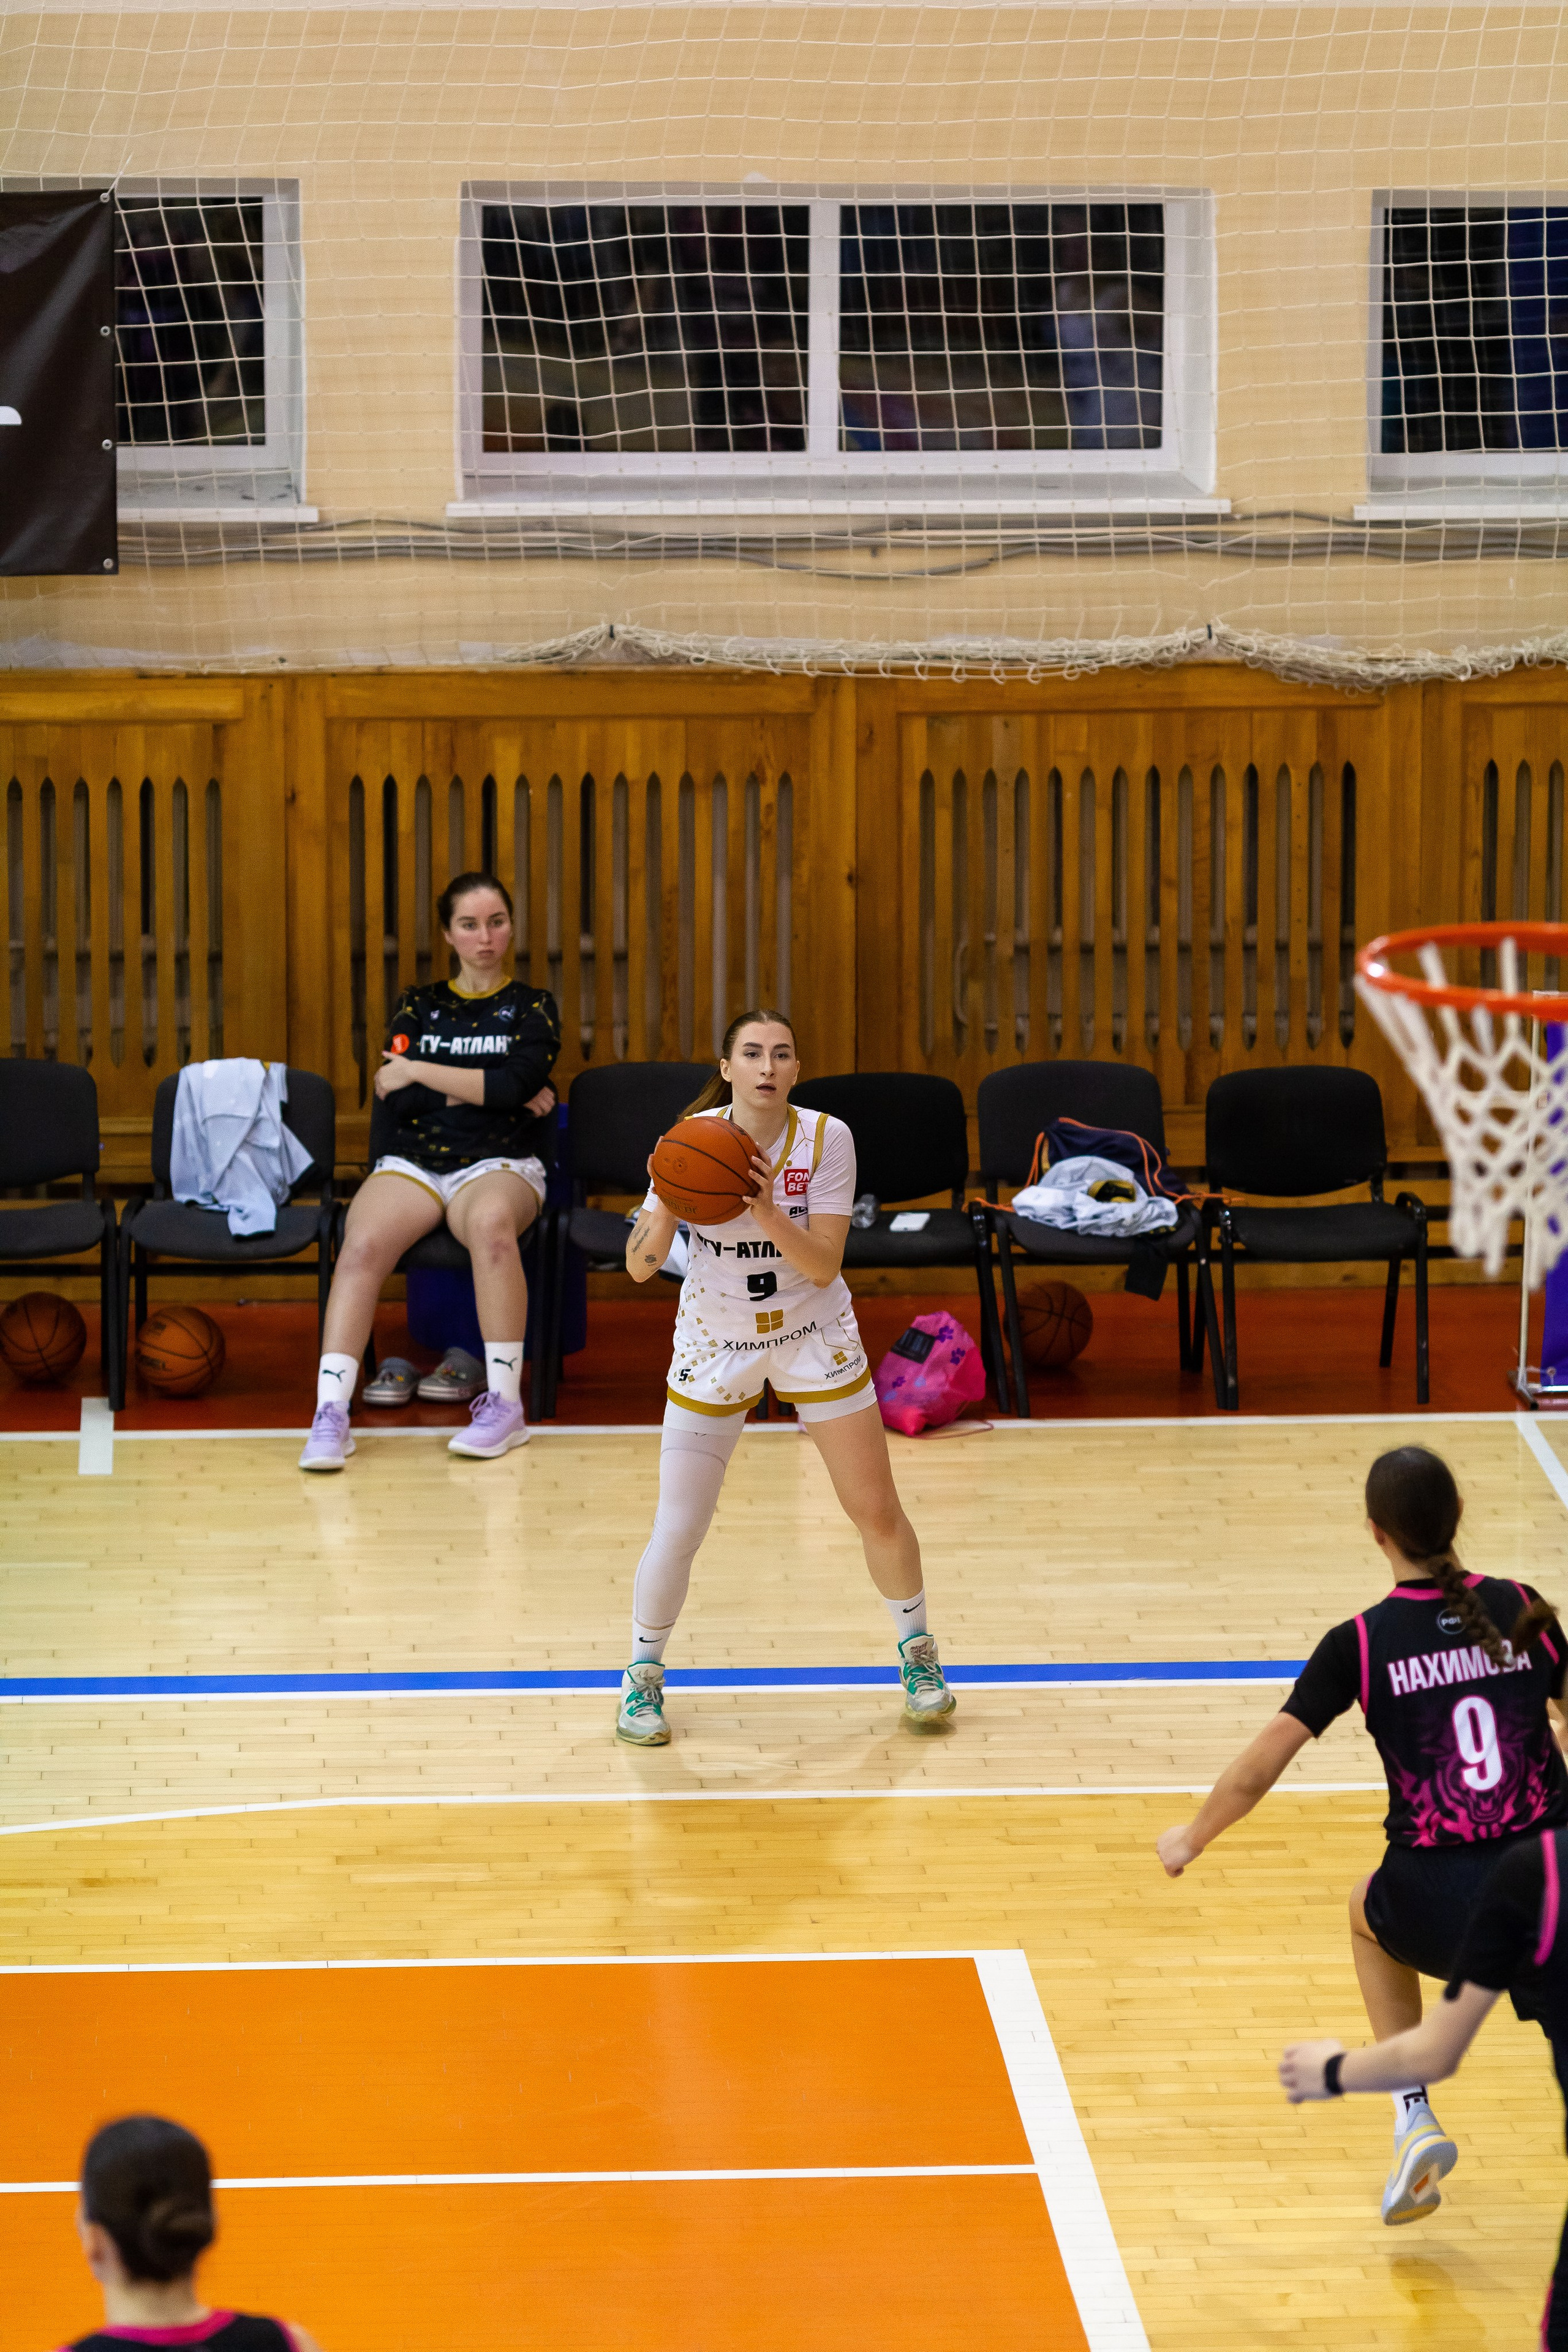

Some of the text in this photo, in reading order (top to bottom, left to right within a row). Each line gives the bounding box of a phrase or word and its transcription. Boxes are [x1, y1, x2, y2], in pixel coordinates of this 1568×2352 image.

[786, 1172, 809, 1182] FON
[746, 1271, 778, 1302] 9
[722, 1321, 817, 1350] ХИМПРОМ
[1453, 1695, 1503, 1790] 9
